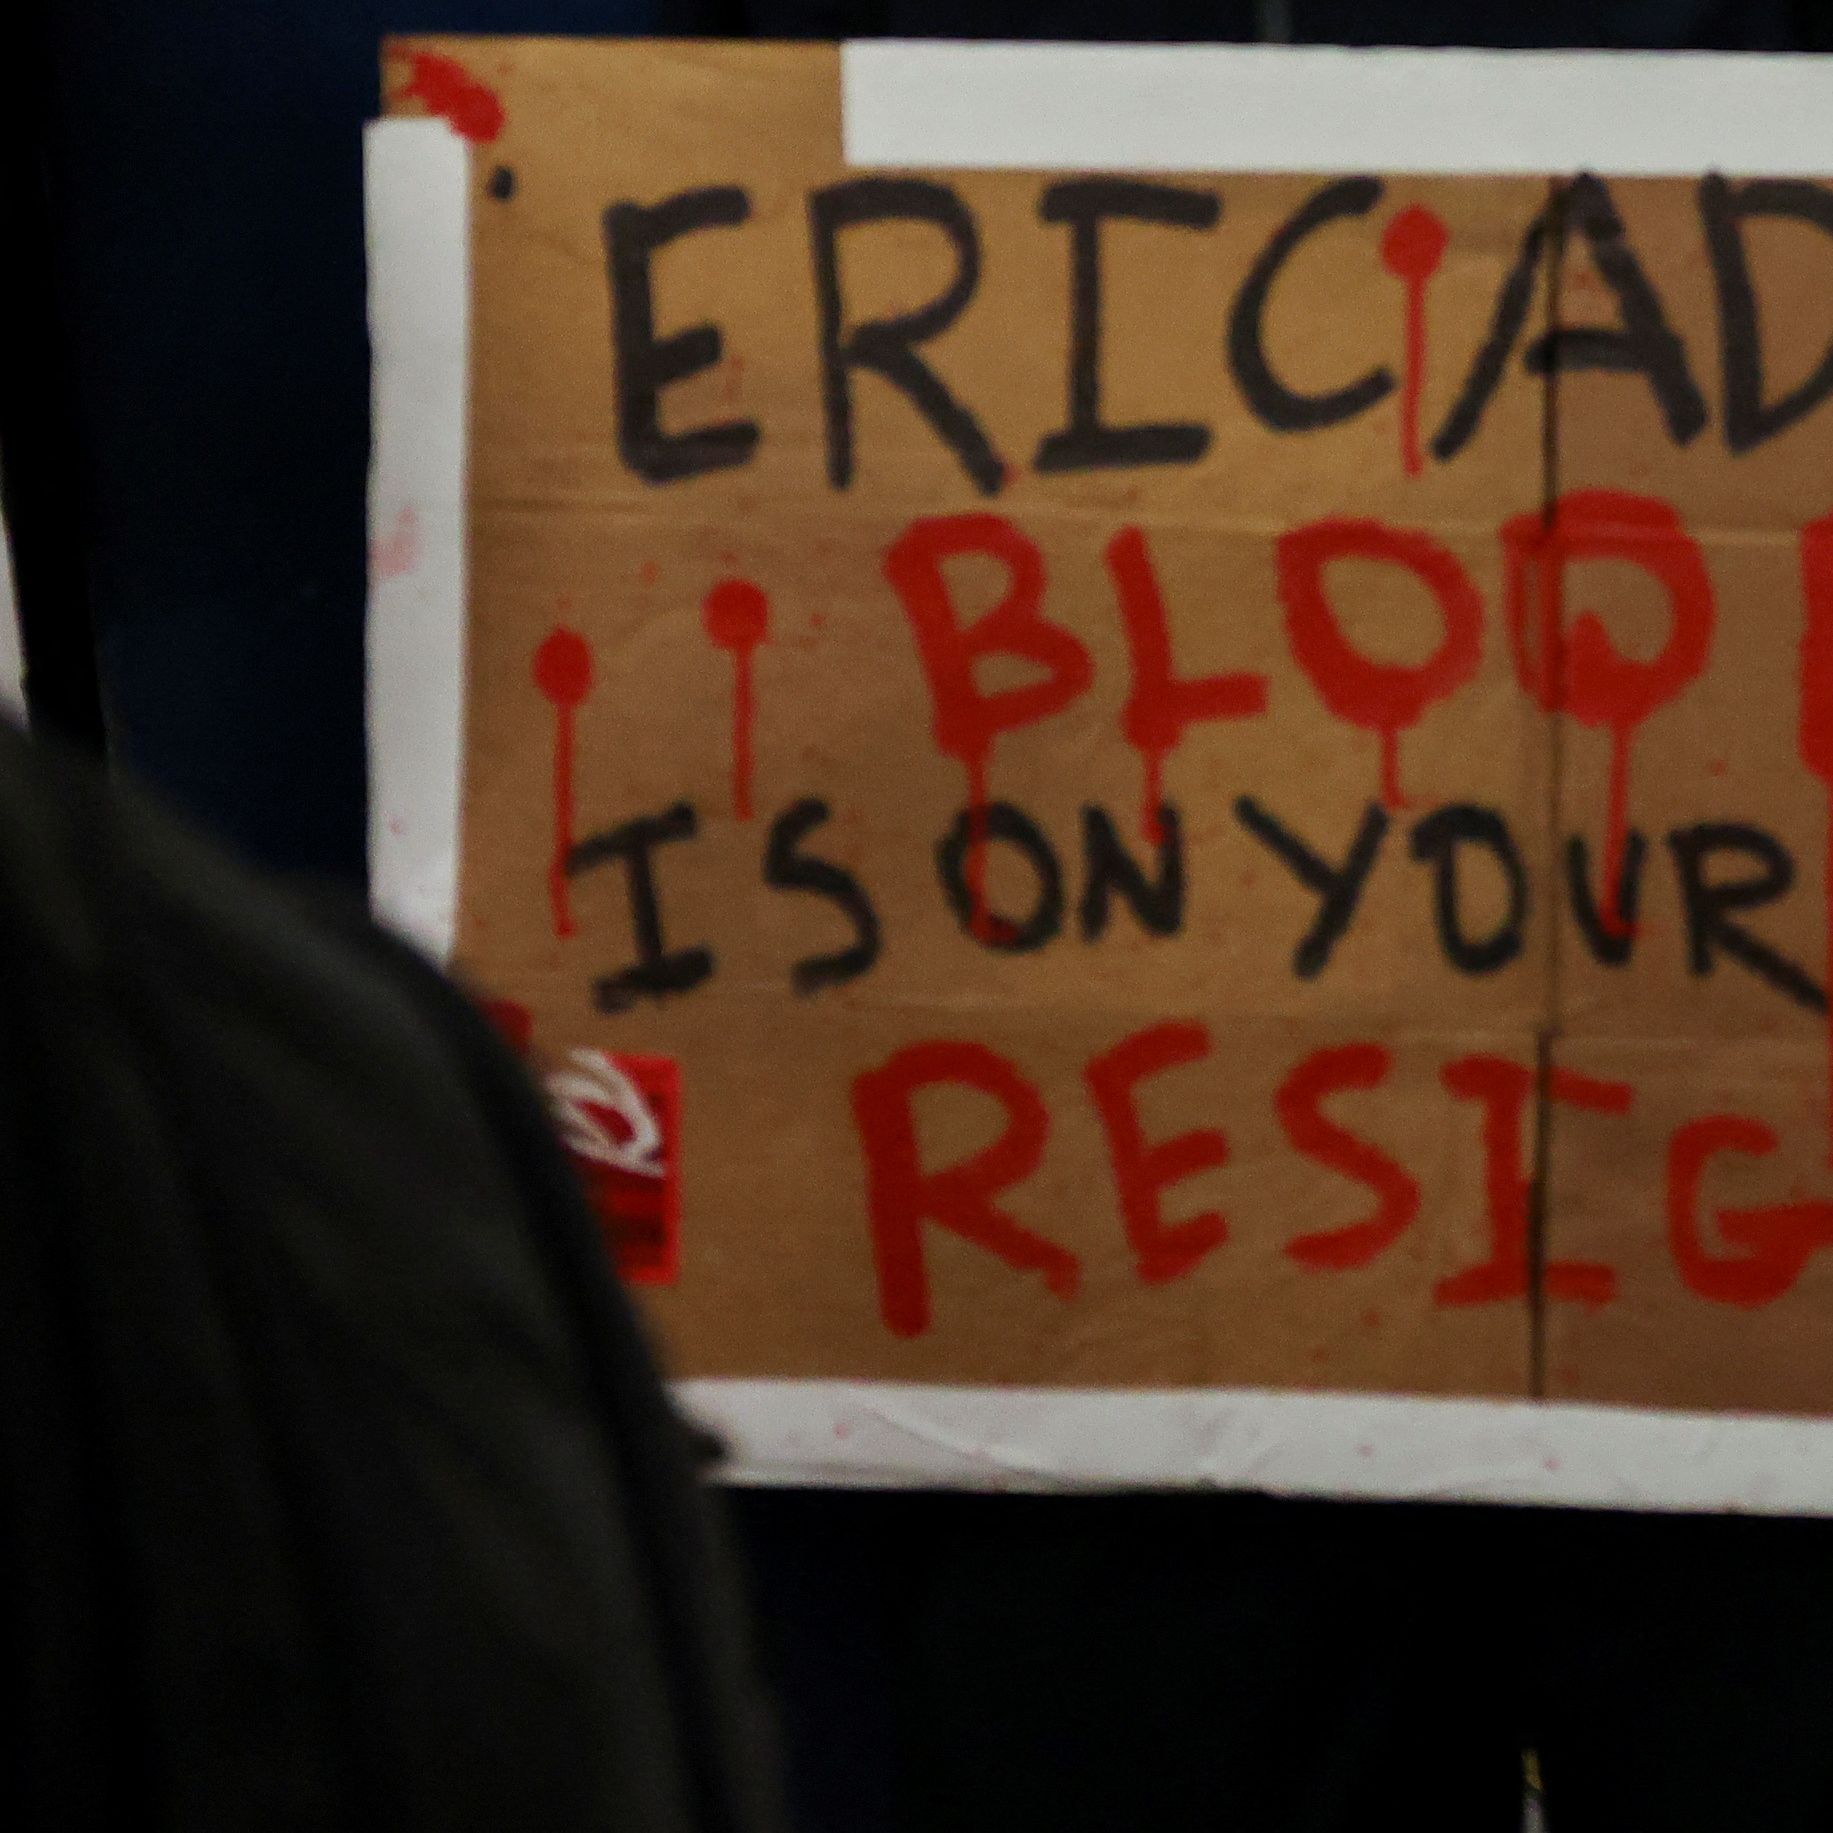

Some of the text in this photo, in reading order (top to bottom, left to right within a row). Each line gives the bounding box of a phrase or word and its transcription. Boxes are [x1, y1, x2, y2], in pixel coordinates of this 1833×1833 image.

[605, 176, 1396, 495] ERIC
[563, 796, 882, 1013] IS
[933, 799, 1186, 954] ON
[1234, 794, 1832, 1020] YOUR
